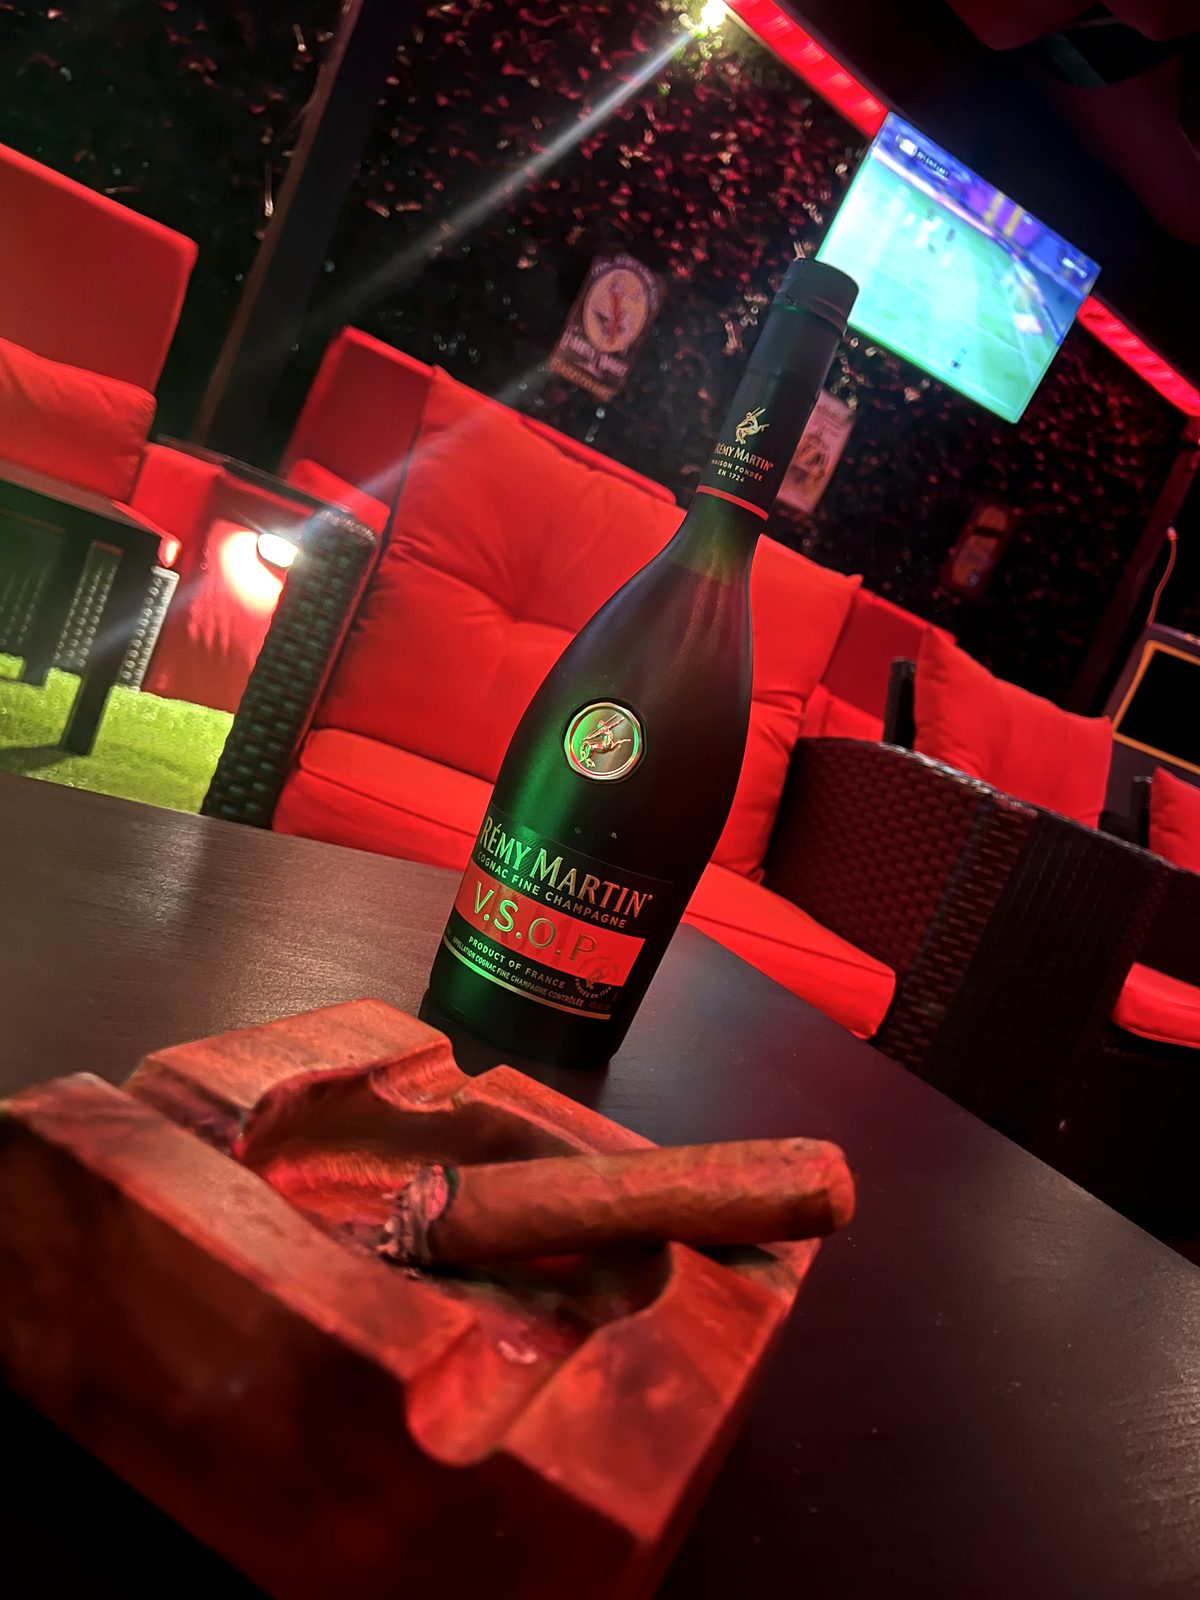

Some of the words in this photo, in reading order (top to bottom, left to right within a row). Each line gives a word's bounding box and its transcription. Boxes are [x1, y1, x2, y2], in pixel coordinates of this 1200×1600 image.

[728, 472, 745, 483] 1724
[734, 447, 770, 472] MARTIN
[735, 465, 763, 482] FONDÉE
[477, 851, 509, 879] COGNAC
[511, 874, 540, 896] FINE
[545, 891, 628, 929] CHAMPAGNE
[479, 815, 532, 871] RÉMY
[529, 848, 647, 918] MARTIN
[468, 936, 506, 963] PRODUCT
[508, 959, 522, 971] OF
[525, 967, 566, 990] FRANCE
[475, 954, 497, 974] COGNAC
[496, 967, 511, 981] FINE
[510, 974, 548, 997] CHAMPAGNE
[548, 990, 585, 1008] CONTRÔLÉE
